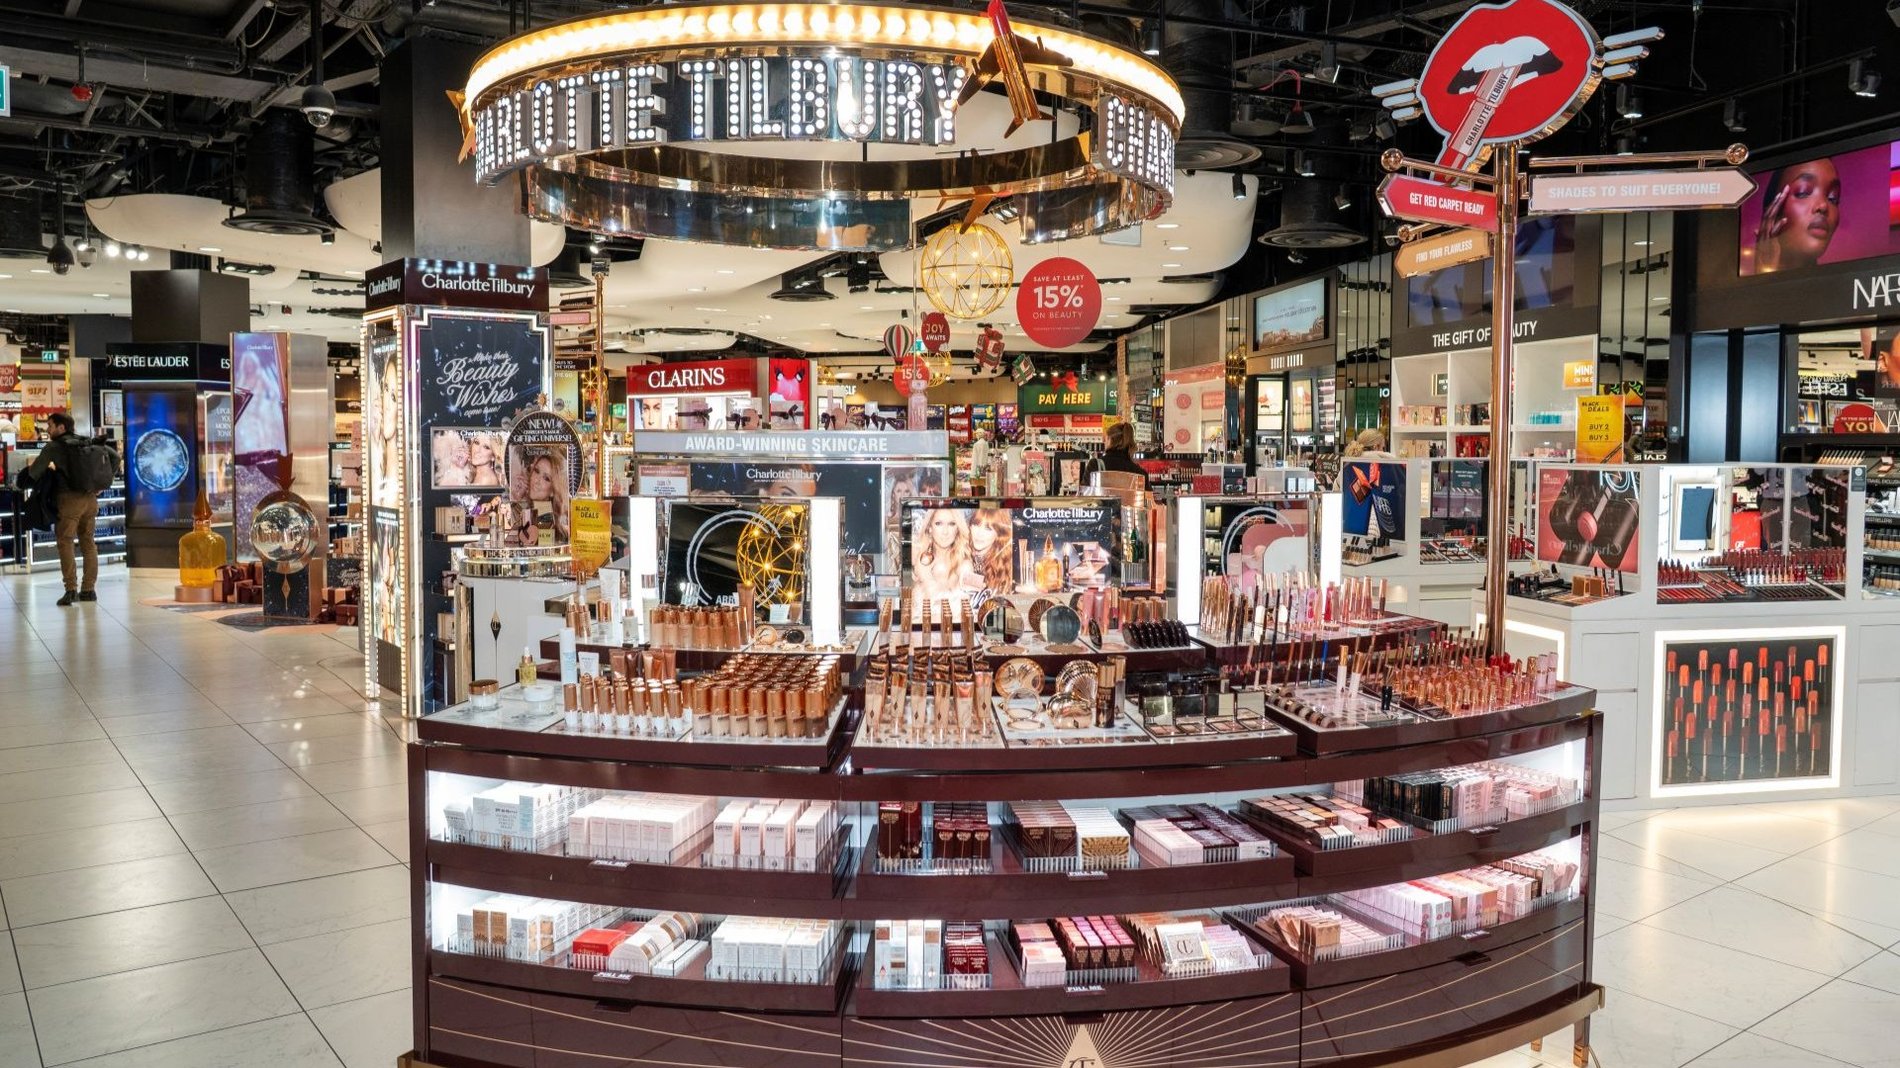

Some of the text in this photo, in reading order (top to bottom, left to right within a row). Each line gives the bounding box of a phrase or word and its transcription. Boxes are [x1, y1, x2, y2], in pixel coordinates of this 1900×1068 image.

[678, 57, 968, 145] TILBURY
[1464, 72, 1509, 146] CHARLOTTE TILBURY
[1548, 182, 1721, 198] SHADES TO SUIT EVERYONE!
[1409, 191, 1485, 216] GET RED CARPET READY
[1416, 239, 1473, 263] FIND YOUR FLAWLESS
[1049, 310, 1083, 319] BEAUTY
[926, 323, 945, 332] JOY
[1432, 332, 1450, 348] THE
[1452, 329, 1474, 345] GIFT
[1476, 327, 1491, 342] OF
[147, 355, 189, 368] LAUDER
[436, 356, 520, 387] Beauty
[647, 367, 726, 389] CLARINS
[446, 380, 519, 408] Wishes
[1038, 392, 1092, 405] PAY HERE
[528, 419, 556, 429] NEW!
[539, 434, 572, 442] UNIVERSE!
[685, 436, 888, 452] AWARD-WINNING SKINCARE
